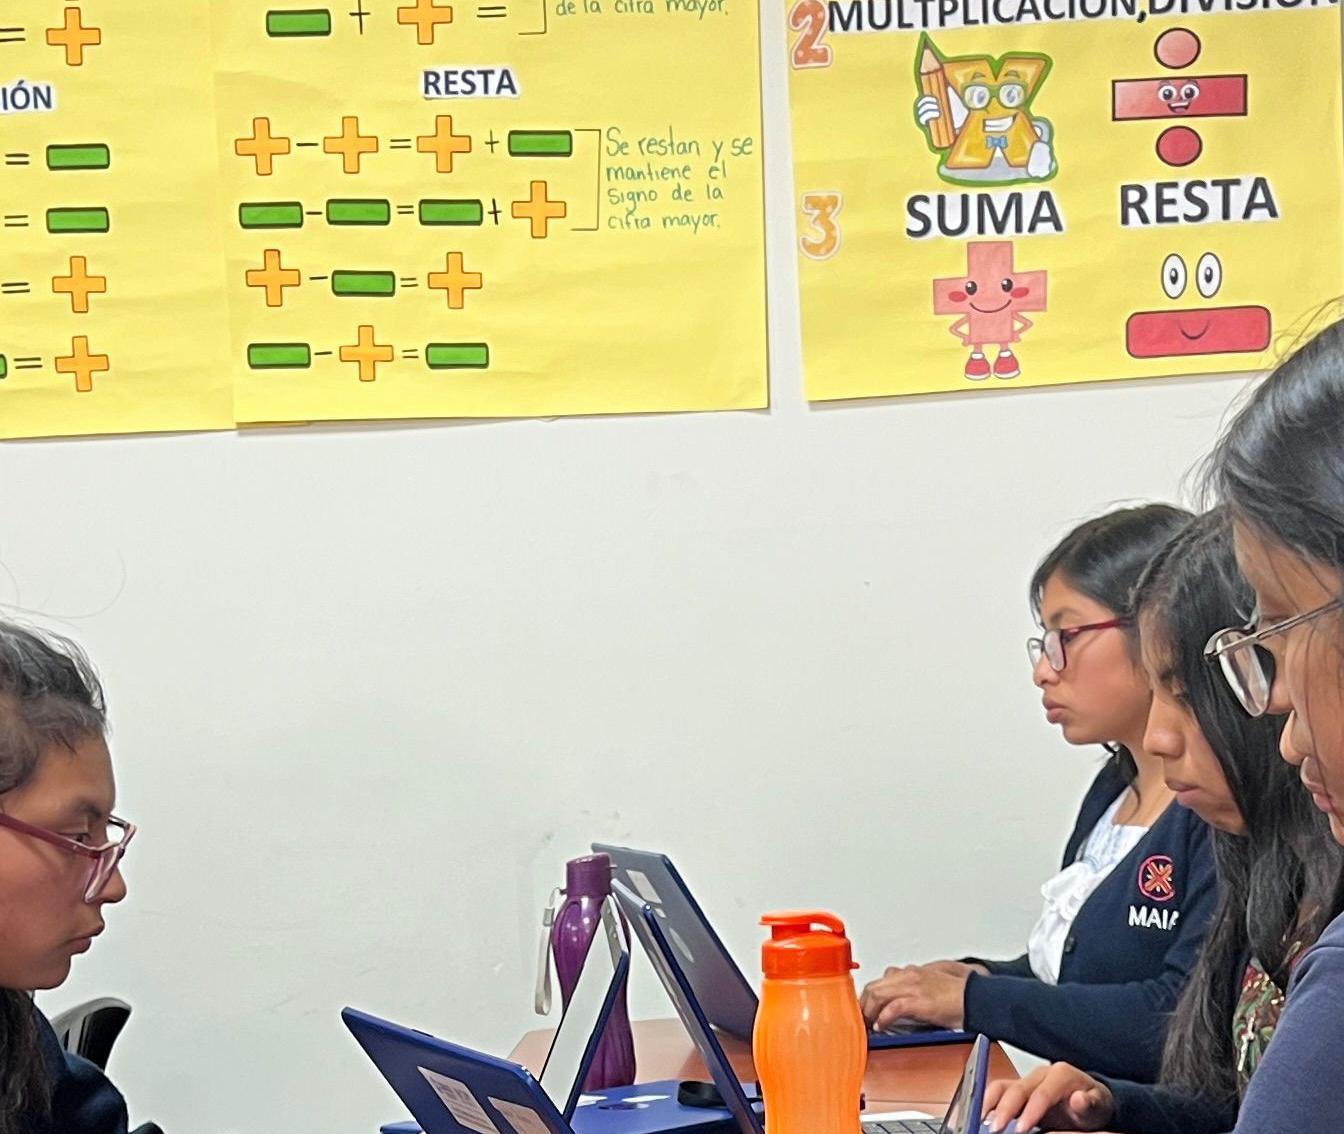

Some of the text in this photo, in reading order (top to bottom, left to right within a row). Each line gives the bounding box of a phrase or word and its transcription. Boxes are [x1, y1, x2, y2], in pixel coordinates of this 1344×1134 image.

[424, 69, 517, 95] RESTA
[606, 125, 753, 163] Se restan y se
[606, 160, 726, 181] mantiene el
[672, 182, 692, 201] de
[707, 184, 724, 200] la
[1121, 178, 1278, 227] RESTA
[608, 211, 721, 234] cifra mayor.
[802, 196, 840, 256] 3
[906, 192, 1063, 239] SUMA
